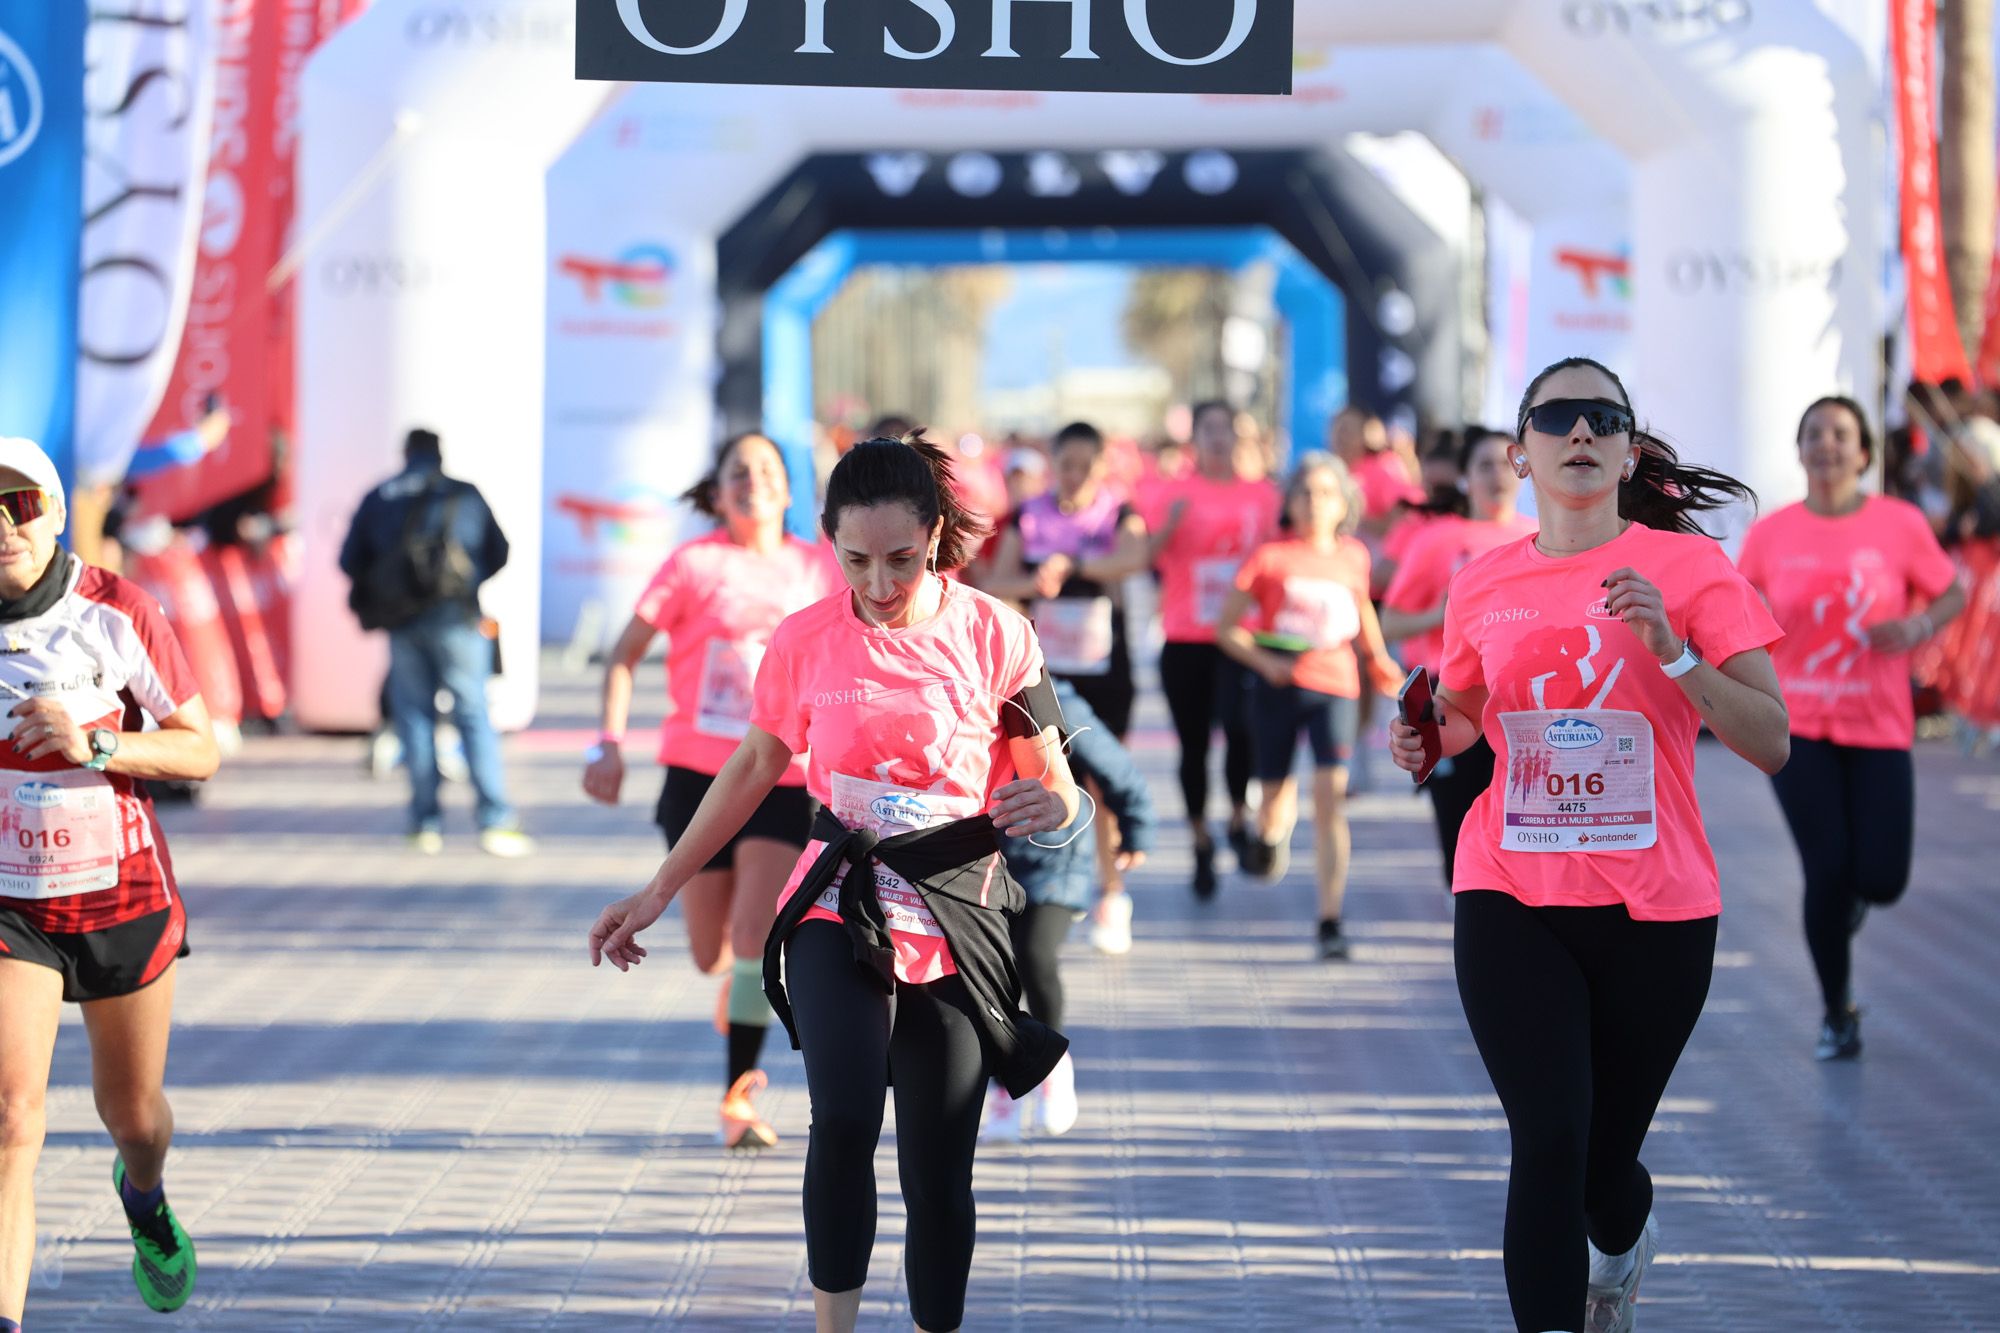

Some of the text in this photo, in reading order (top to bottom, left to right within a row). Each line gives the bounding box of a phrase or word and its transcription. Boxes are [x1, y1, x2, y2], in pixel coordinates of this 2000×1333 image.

[864, 148, 1239, 198] VOLVO
[1483, 608, 1539, 626] OYSHO
[815, 688, 872, 707] OYSHO
[1517, 735, 1540, 744] SUMA
[1547, 731, 1598, 742] ASTURIANA
[1546, 773, 1605, 796] 016
[840, 799, 865, 812] SUMA
[1558, 802, 1586, 812] 4475
[1519, 814, 1635, 825] CARRERA DE LA MUJER VALENCIA
[18, 828, 71, 849] 016
[1517, 832, 1638, 844] OYSHO Santander
[28, 854, 55, 865] 6924
[879, 891, 904, 902] MUJER
